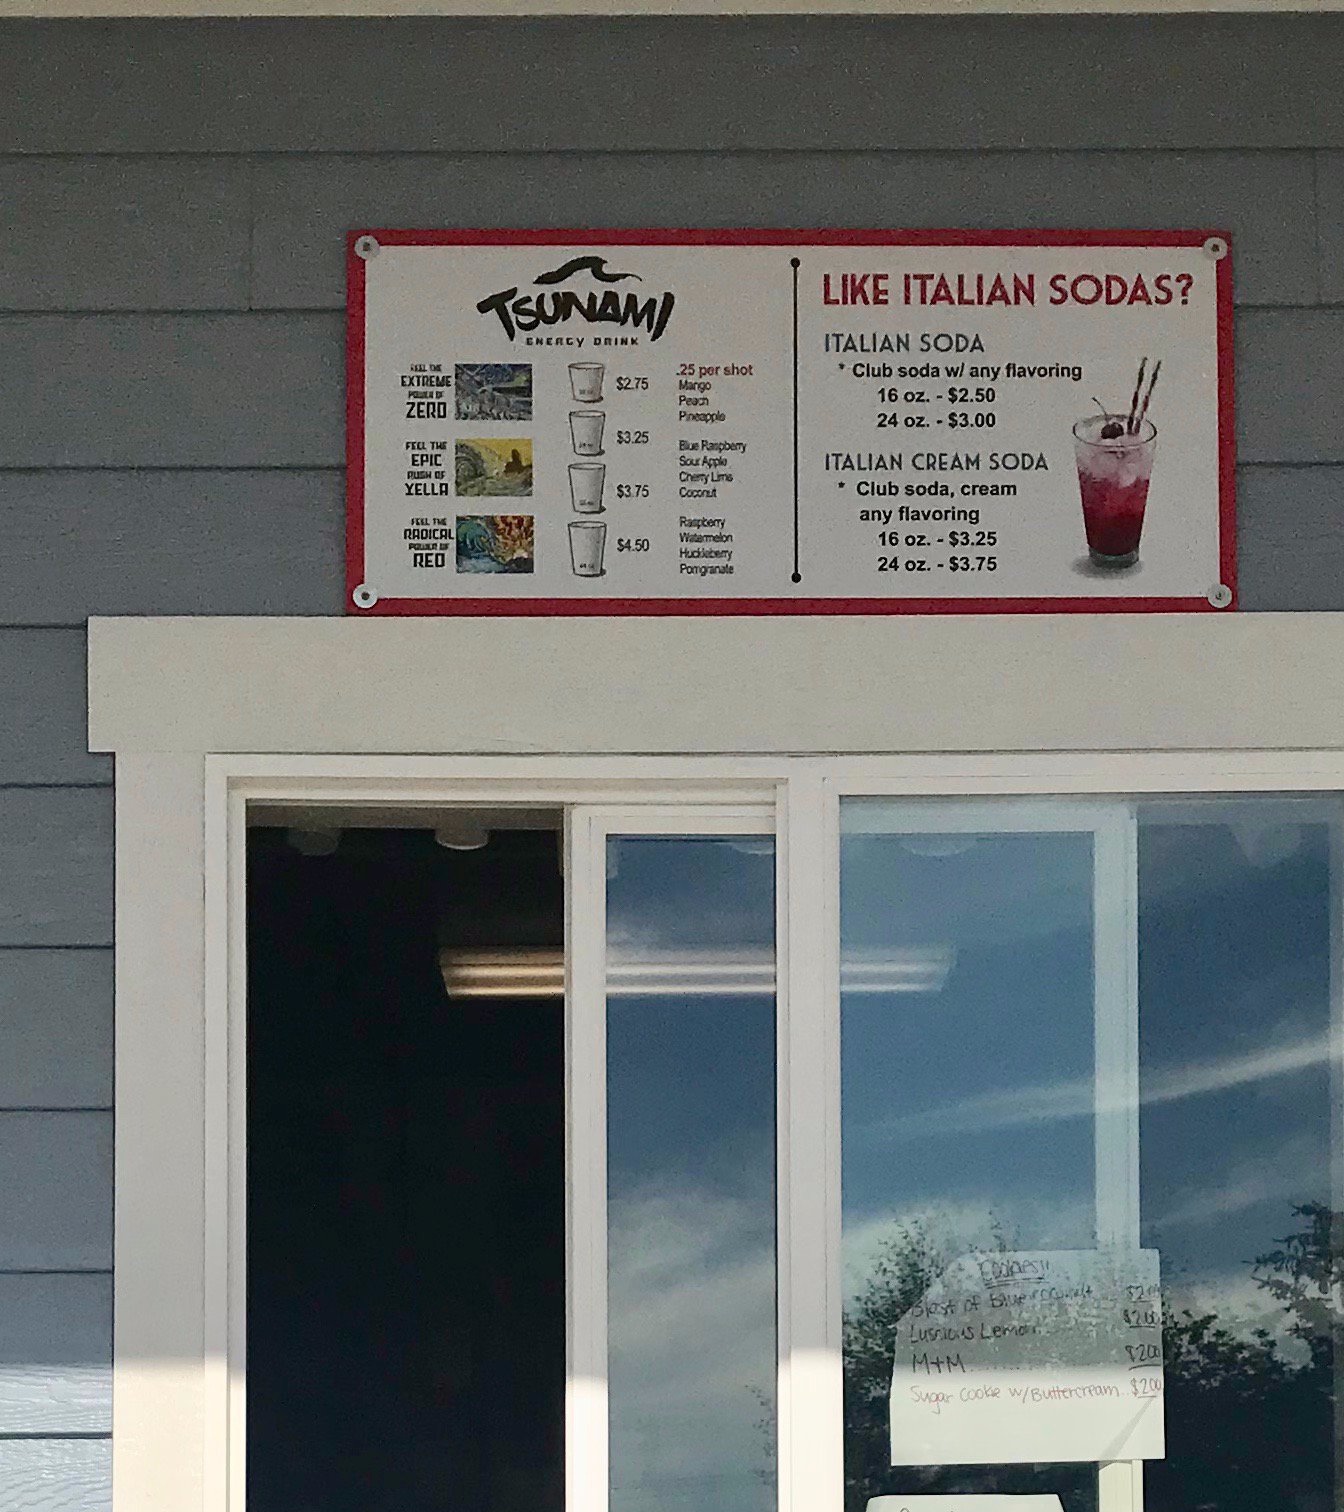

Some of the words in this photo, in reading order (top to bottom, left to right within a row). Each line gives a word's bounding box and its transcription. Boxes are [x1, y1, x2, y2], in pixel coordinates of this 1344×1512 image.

[824, 274, 888, 305] LIKE
[904, 273, 1034, 307] ITALIAN
[1050, 273, 1193, 305] SODAS?
[594, 337, 638, 345] DRINK
[825, 333, 909, 352] ITALIAN
[920, 334, 984, 353] SODA
[676, 364, 695, 375] .25
[699, 366, 720, 378] per
[724, 363, 753, 376] shot
[853, 363, 892, 377] Club
[897, 363, 940, 378] soda
[945, 362, 965, 377] w/
[970, 367, 1001, 381] any
[1006, 363, 1082, 381] flavoring
[401, 375, 451, 387] EXTREME
[617, 376, 648, 391] $2.75
[878, 388, 898, 403] 16
[904, 392, 929, 402] oz.
[948, 387, 995, 404] $2.50
[406, 402, 446, 418] ZERO
[617, 431, 649, 444] $3.25
[826, 453, 902, 471] ITALIAN
[913, 452, 981, 471] CREAM
[989, 452, 1049, 471] SODA
[617, 484, 649, 498] $3.75
[617, 538, 649, 552] $4.50
